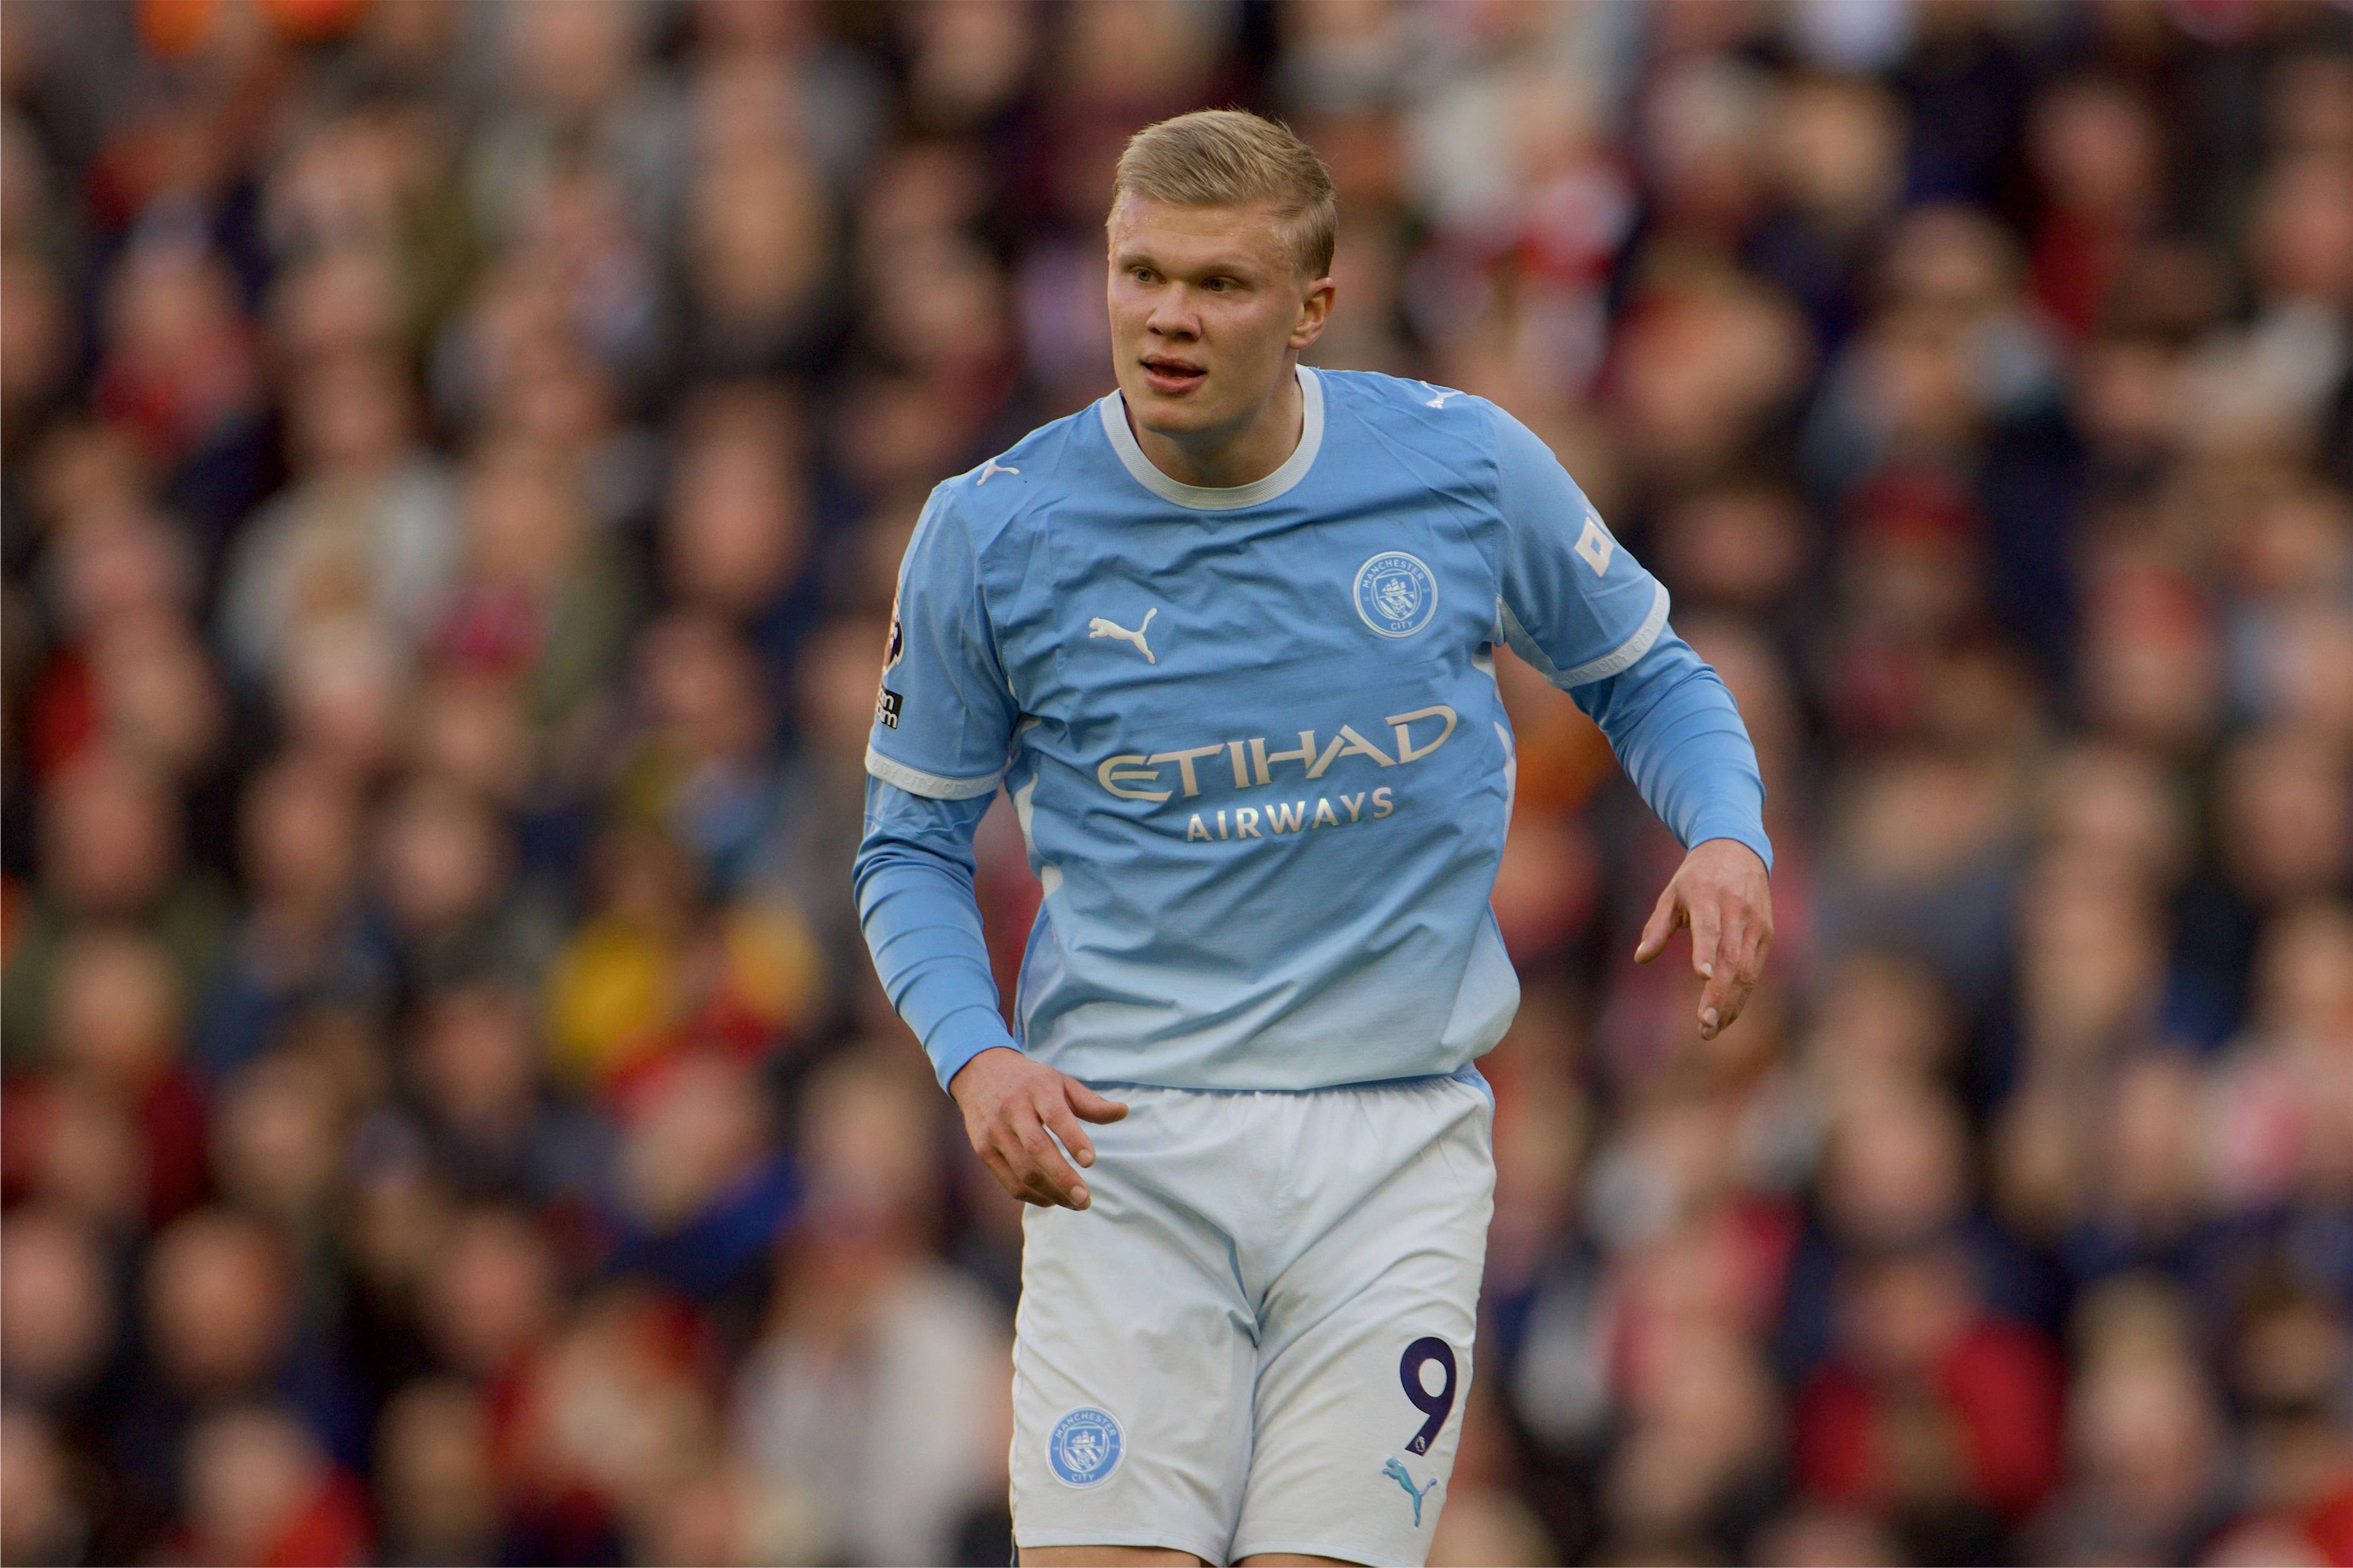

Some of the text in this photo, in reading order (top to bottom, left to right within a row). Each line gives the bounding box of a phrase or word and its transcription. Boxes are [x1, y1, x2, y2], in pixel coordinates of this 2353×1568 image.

[1362, 559, 1425, 588] MANCHESTER
[1390, 620, 1413, 631] CITY
[1598, 649, 1629, 673] CITY
[1096, 705, 1457, 802] ETIHAD
[903, 772, 937, 792] CITY
[1187, 787, 1394, 842] AIRWAYS
[1399, 1336, 1457, 1457] 9
[1055, 1412, 1117, 1439] MANCHESTER
[1071, 1473, 1095, 1482] CITY
